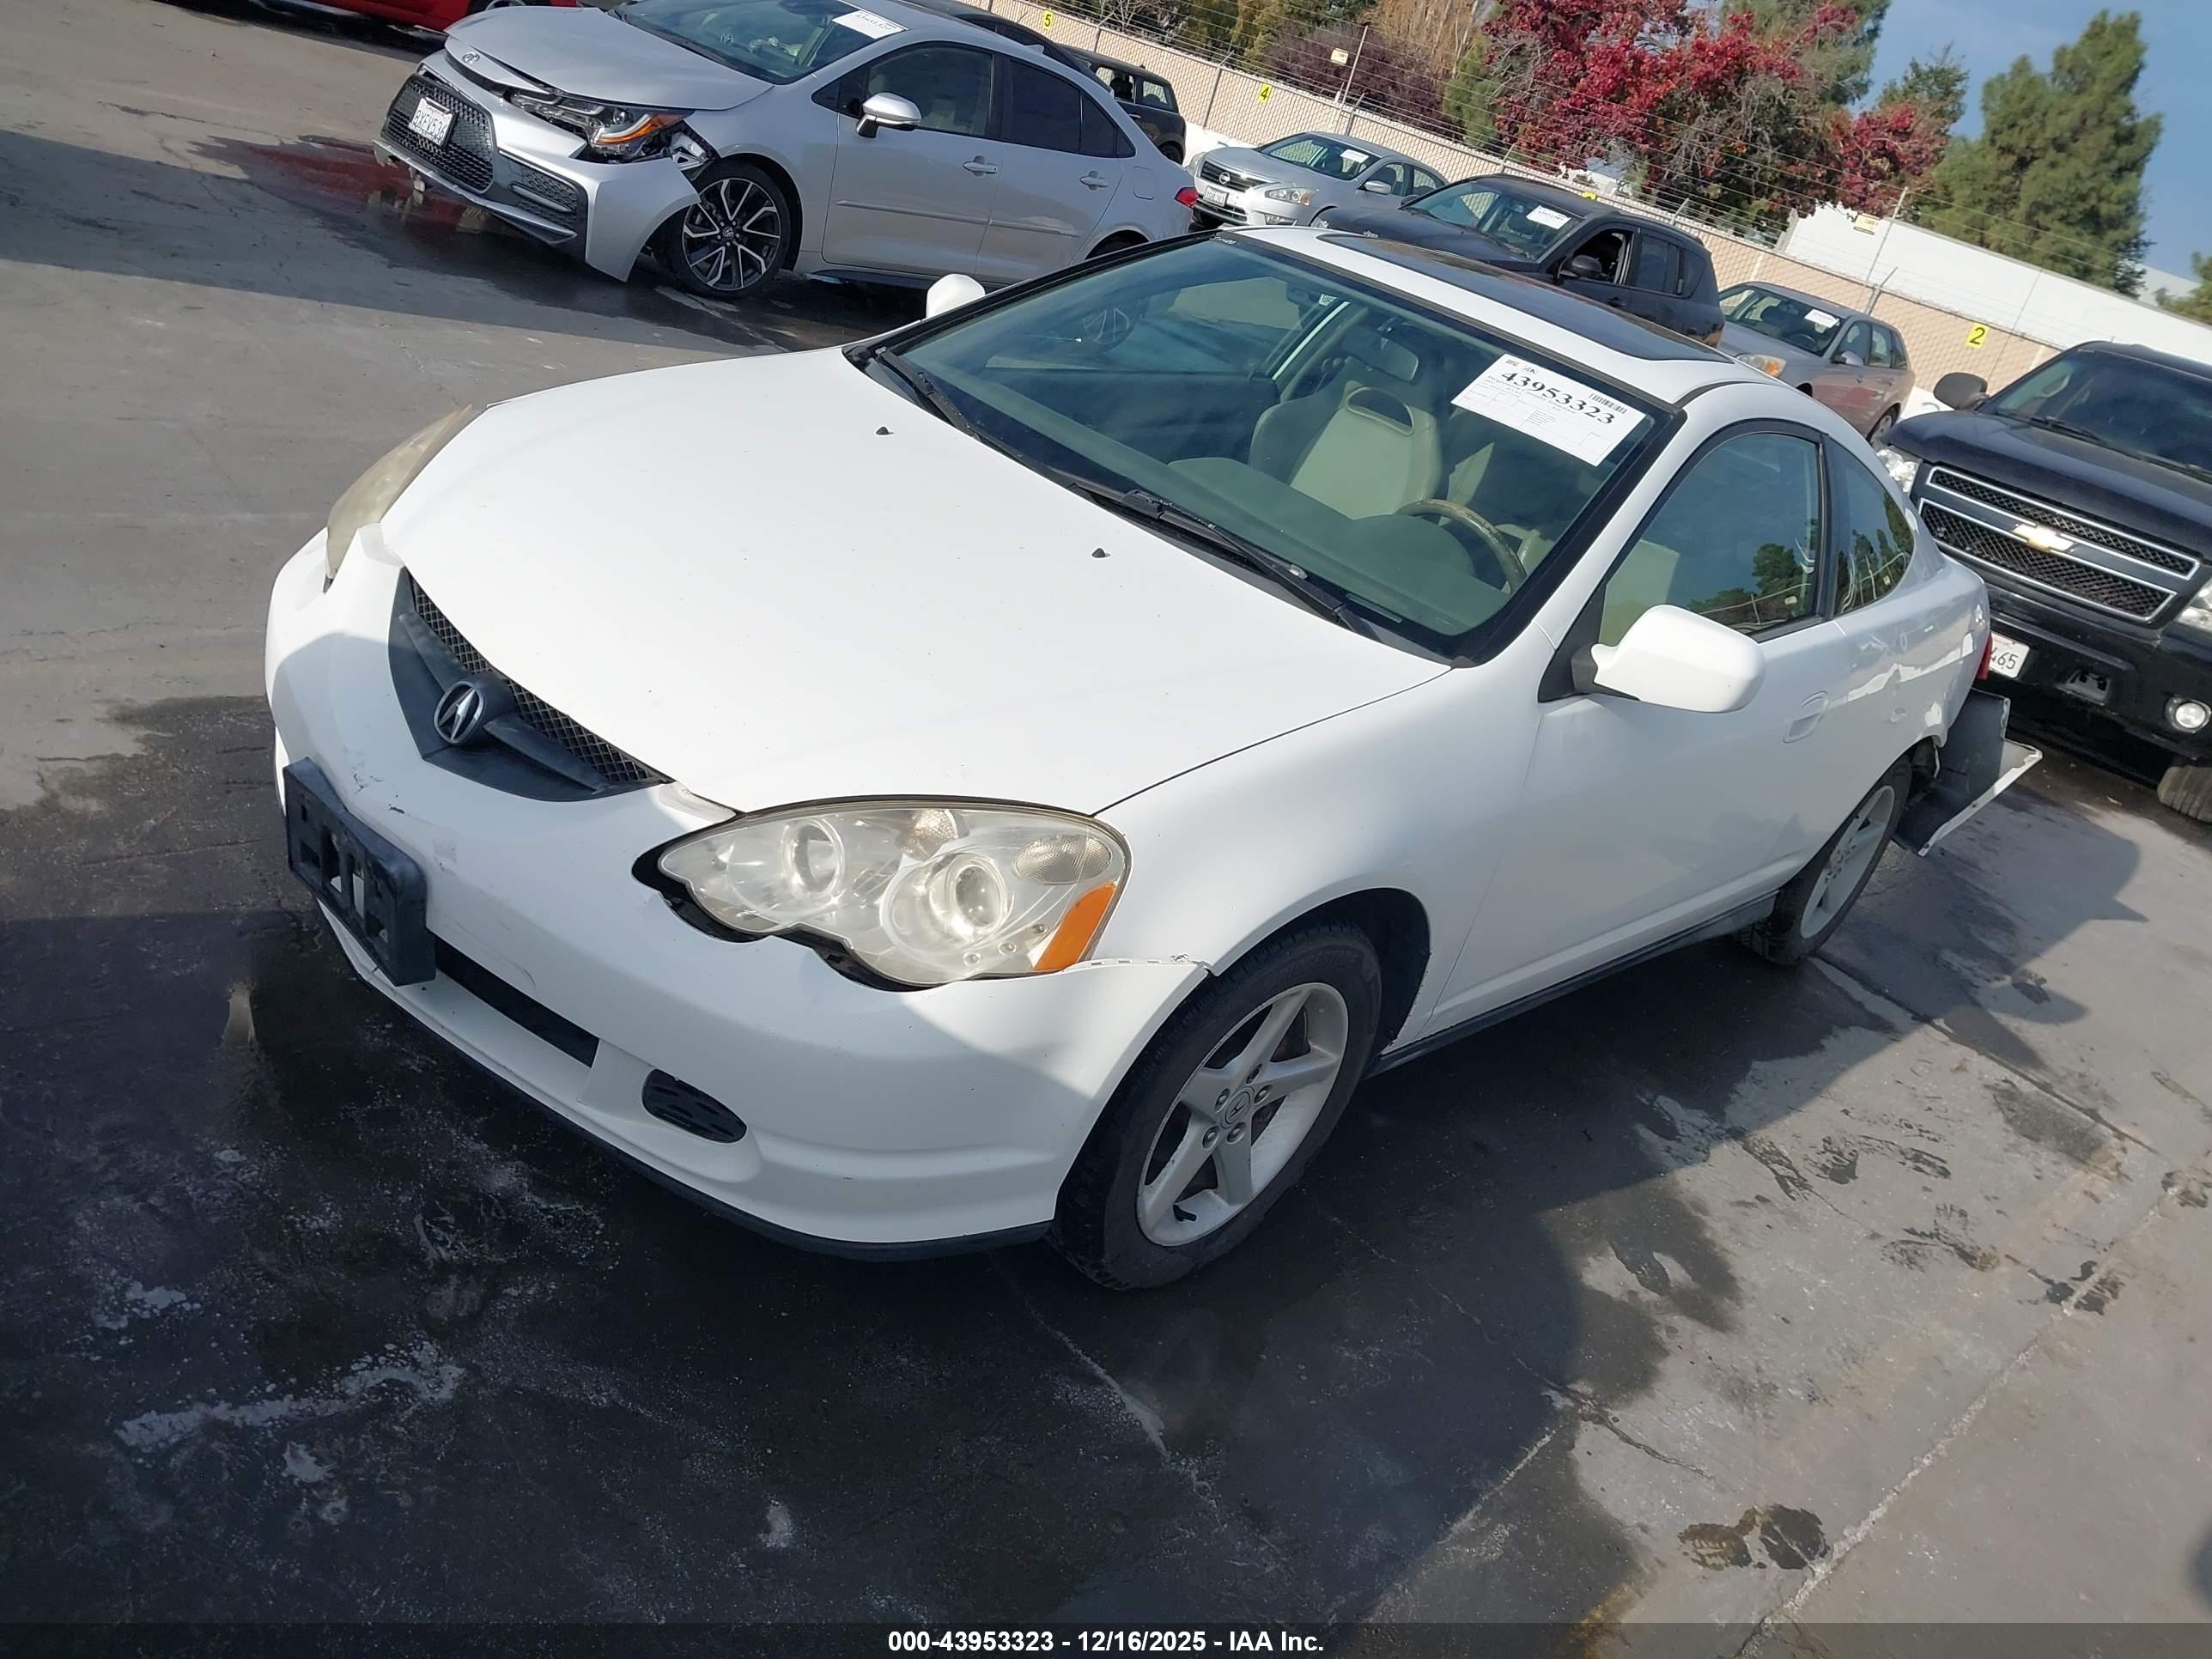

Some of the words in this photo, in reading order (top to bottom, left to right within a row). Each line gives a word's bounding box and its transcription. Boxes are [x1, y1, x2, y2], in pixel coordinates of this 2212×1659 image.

[1044, 13, 1052, 27] 5
[1260, 87, 1270, 101] 4
[1969, 326, 1986, 345] 2
[1499, 370, 1617, 425] 43953323
